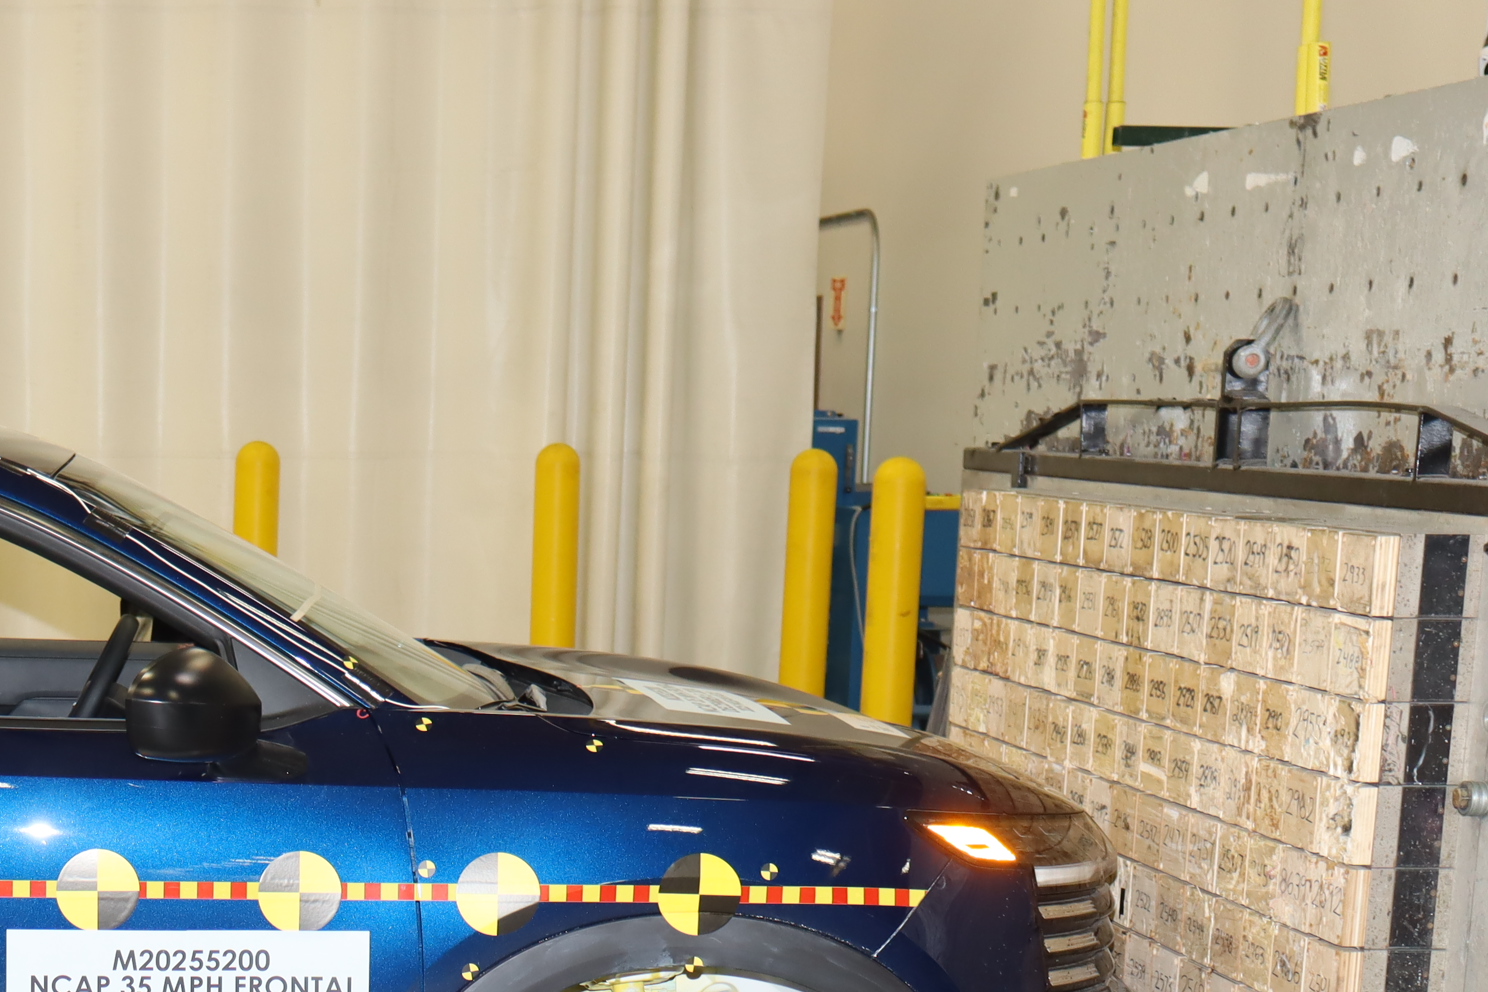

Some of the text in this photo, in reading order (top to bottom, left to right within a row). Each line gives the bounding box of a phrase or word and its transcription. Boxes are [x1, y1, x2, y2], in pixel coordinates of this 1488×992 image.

[1184, 532, 1209, 561] 2505
[1213, 536, 1236, 567] 2520
[1342, 562, 1366, 586] 2933
[1238, 621, 1259, 650] 2519
[112, 949, 271, 972] M20255200
